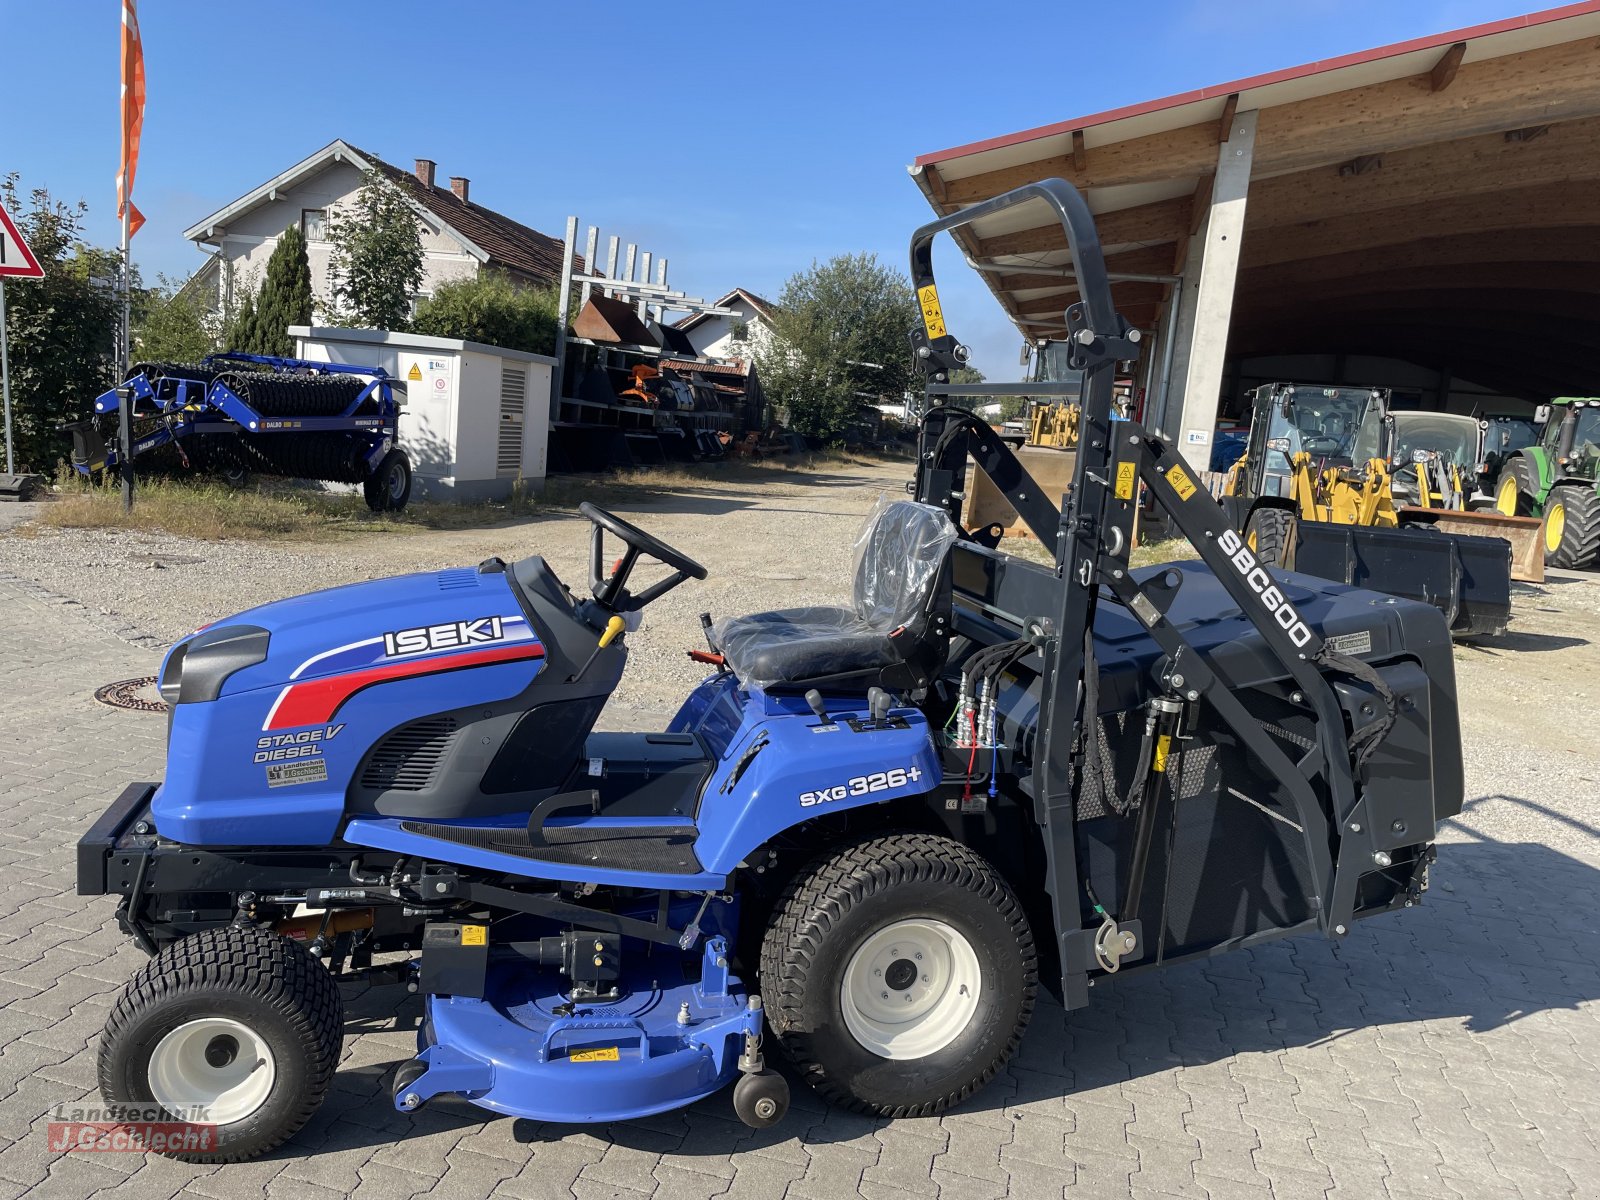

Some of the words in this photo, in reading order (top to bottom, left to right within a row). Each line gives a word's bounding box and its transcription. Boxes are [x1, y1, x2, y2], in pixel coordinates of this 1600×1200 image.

[138, 439, 155, 450] DALBO
[1217, 529, 1311, 648] SBC600
[383, 615, 504, 657] ISEKI
[257, 729, 324, 749] STAGE
[325, 723, 346, 740] V
[253, 744, 323, 764] DIESEL
[283, 760, 324, 770] Landtechnik
[285, 766, 325, 778] J.Gschlecht
[799, 785, 848, 808] SXG
[848, 766, 922, 797] 326+
